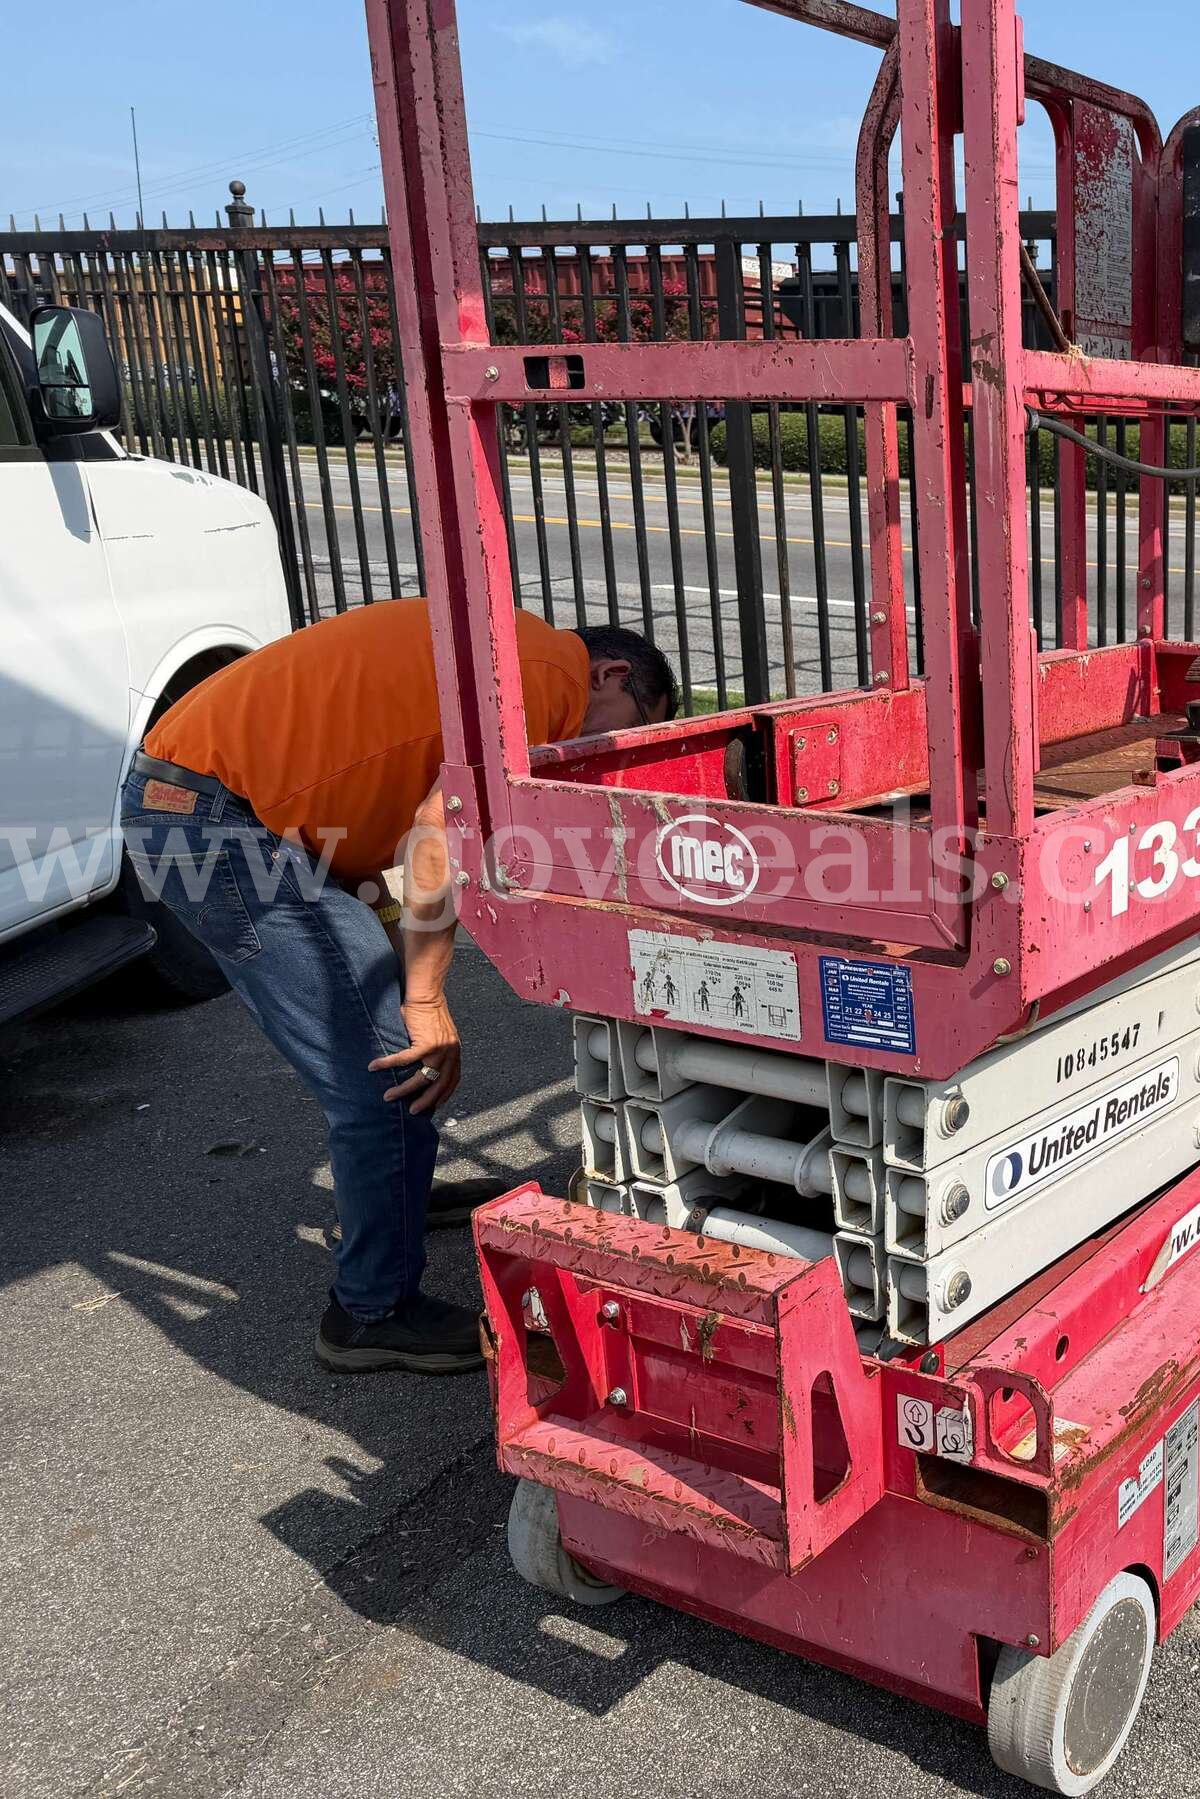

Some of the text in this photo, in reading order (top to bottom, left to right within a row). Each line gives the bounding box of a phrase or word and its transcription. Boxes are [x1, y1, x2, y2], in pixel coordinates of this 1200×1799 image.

[671, 835, 745, 887] mec
[850, 976, 889, 986] United Rentals
[1056, 1022, 1141, 1083] 10845547
[1028, 1071, 1171, 1176] United Rentals
[1142, 1451, 1157, 1471] LOAD
